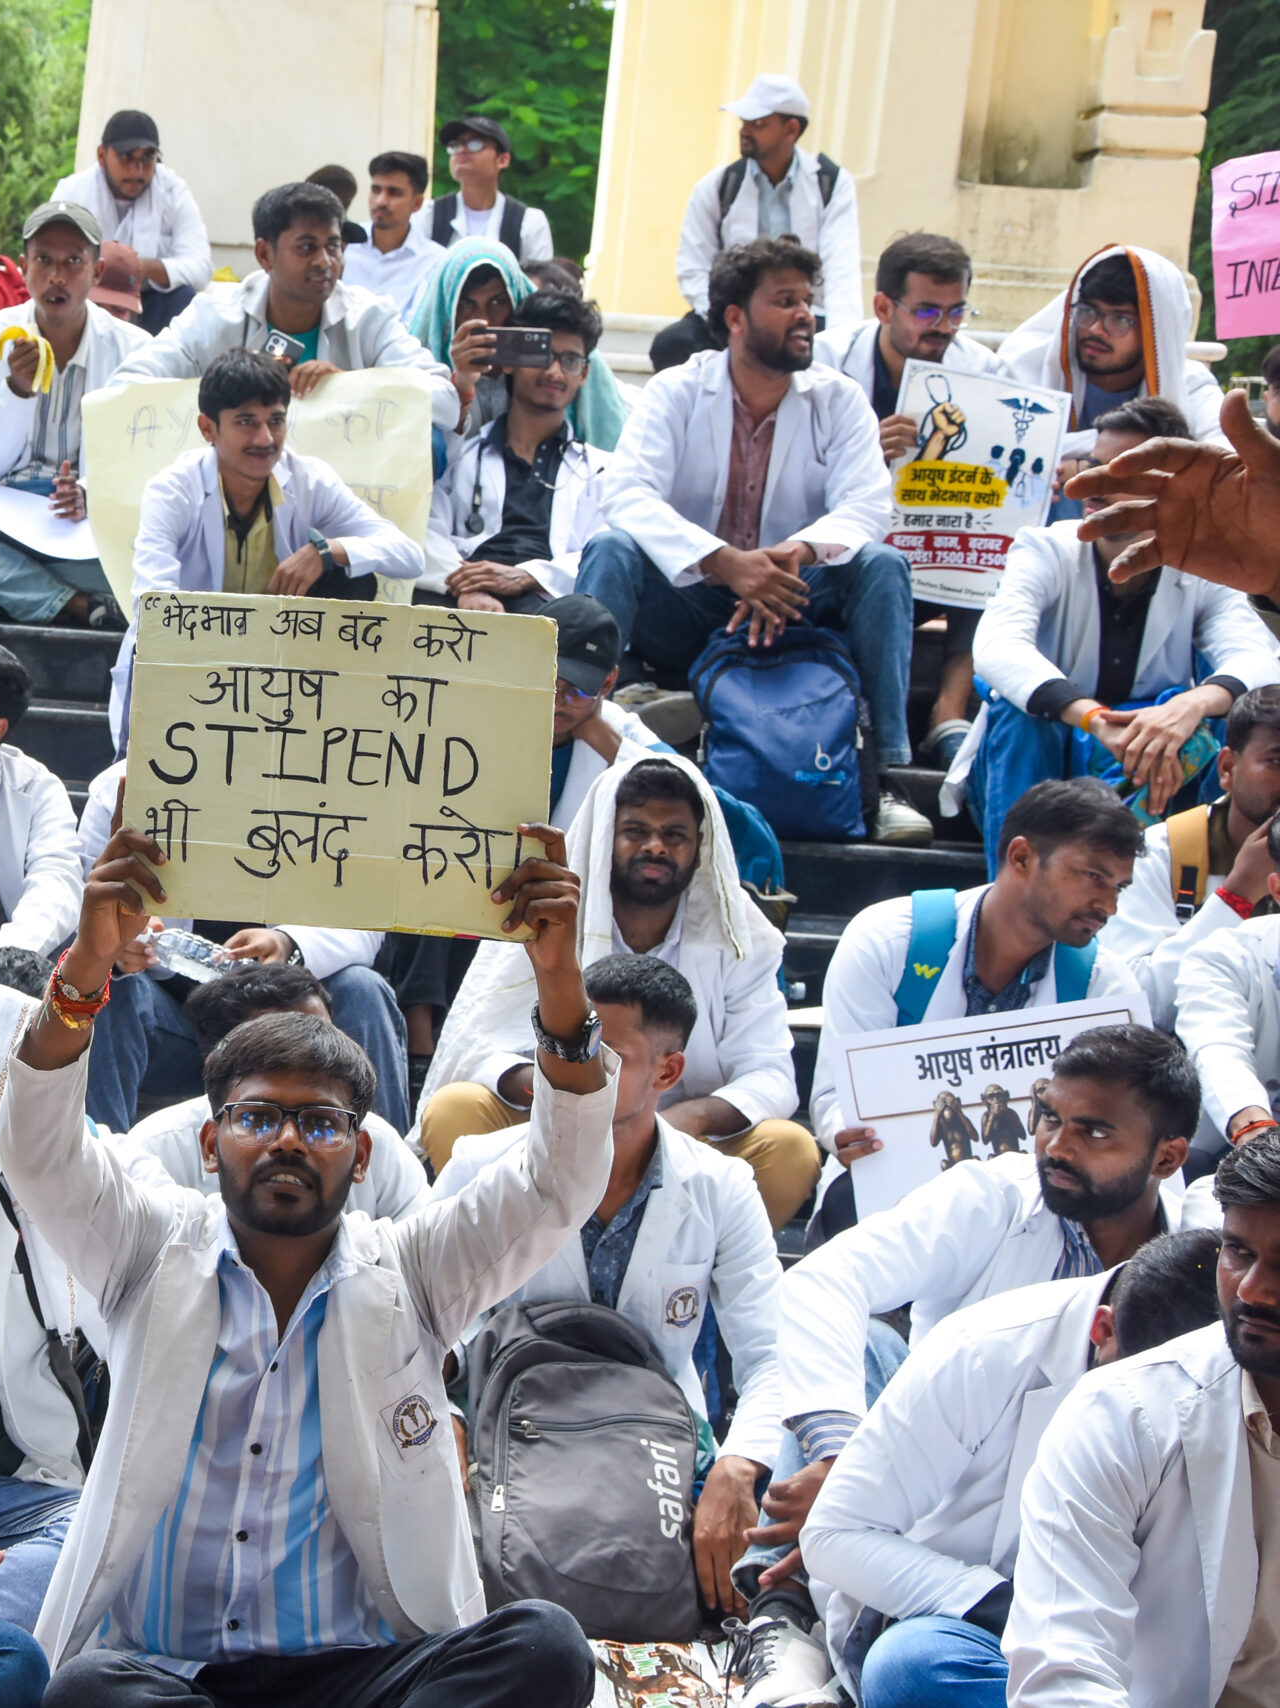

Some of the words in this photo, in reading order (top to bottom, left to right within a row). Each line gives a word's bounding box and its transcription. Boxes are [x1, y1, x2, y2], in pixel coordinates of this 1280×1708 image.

[901, 488, 927, 501] साथ
[929, 486, 972, 504] भेदभाव
[911, 467, 946, 487] आयुष
[949, 465, 979, 485] इंटर्न
[980, 467, 995, 485] के
[935, 514, 963, 529] नारा
[965, 512, 975, 529] है
[935, 550, 965, 564] 7500
[966, 550, 978, 565] से
[271, 609, 326, 642] अब
[338, 611, 389, 653] बंद
[413, 613, 488, 664] करो
[189, 666, 340, 726] आयुष
[381, 674, 449, 727] का
[148, 721, 480, 797] STIPEND
[144, 798, 202, 863] भी
[233, 801, 368, 888] बुलंद
[915, 1047, 974, 1087] आयुष
[976, 1036, 1061, 1072] मंत्रालय
[640, 1438, 684, 1545] safari
